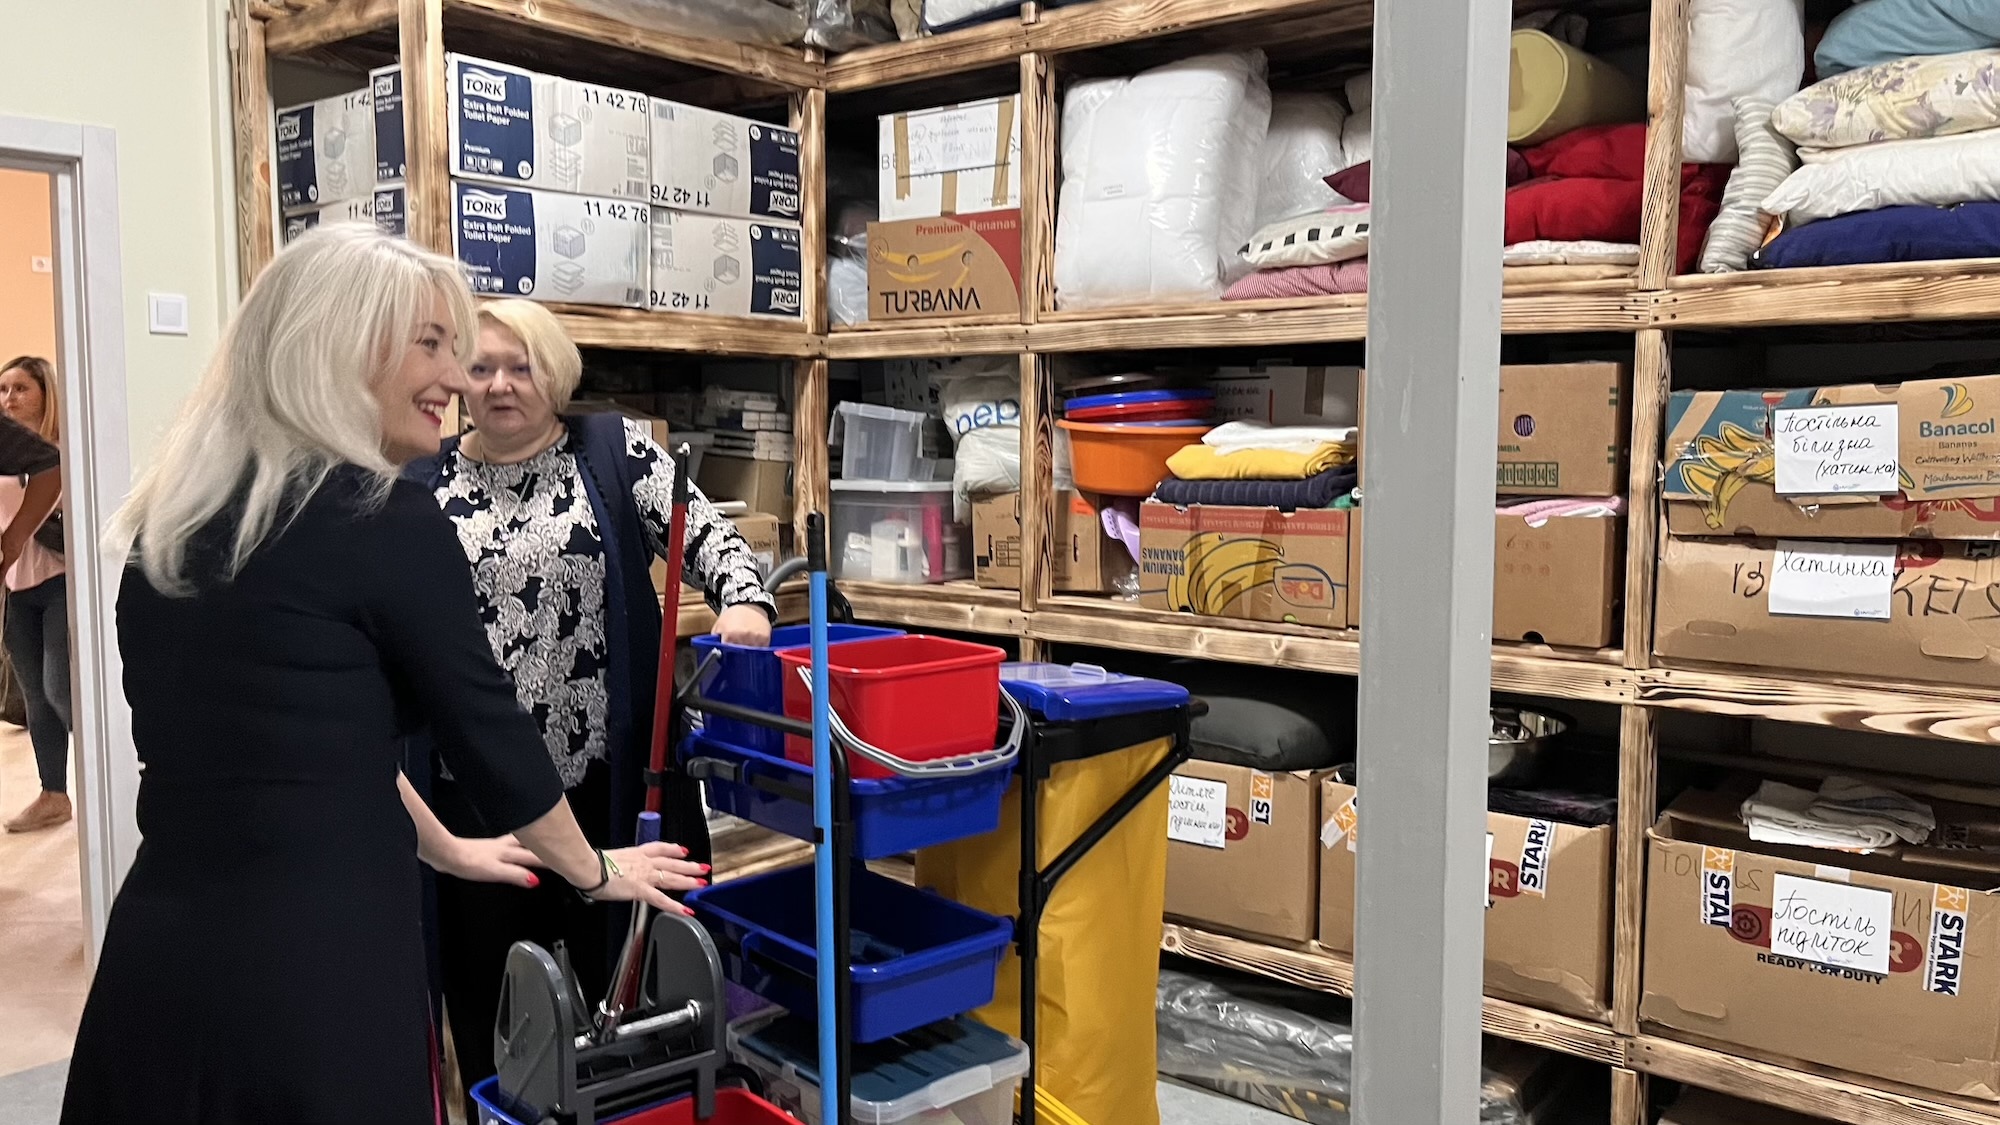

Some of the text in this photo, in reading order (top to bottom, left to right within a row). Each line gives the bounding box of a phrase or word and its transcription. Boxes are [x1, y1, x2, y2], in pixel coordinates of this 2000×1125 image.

[465, 78, 503, 97] TORK
[583, 88, 600, 104] 11
[606, 92, 626, 110] 42
[464, 99, 530, 120] Extra Soft Folded
[464, 110, 511, 126] Toilet Paper
[280, 123, 298, 137] TORK
[650, 184, 710, 208] 11 42 76
[772, 192, 797, 208] TORK
[348, 203, 358, 219] 11
[465, 199, 503, 215] TORK
[584, 200, 648, 223] 11 42 76
[463, 219, 531, 236] Extra Soft Folded
[915, 219, 1017, 236] Premium Bananas
[464, 231, 511, 244] Toilet Paper
[672, 292, 690, 307] 42
[695, 294, 710, 310] 11
[773, 291, 798, 304] TORK
[880, 287, 981, 314] TURBANA
[1777, 412, 1882, 434] Постільна
[1919, 417, 1995, 438] Banacol
[1792, 435, 1875, 461] білизна
[1938, 441, 1978, 450] Bananas
[1516, 468, 1524, 481] 12
[1527, 468, 1534, 481] 13
[1538, 468, 1545, 482] 14
[1815, 459, 1897, 481] (хатинка)
[1142, 547, 1185, 561] BANANAS
[1143, 560, 1185, 576] PREMIUM
[1776, 550, 1890, 578] Хатинка
[1281, 580, 1324, 601] Dole
[1774, 889, 1877, 937] Постіль
[1776, 926, 1874, 959] підліток
[1933, 912, 1965, 996] STARK
[1757, 952, 1805, 970] READY
[1843, 969, 1883, 985] DUTY
